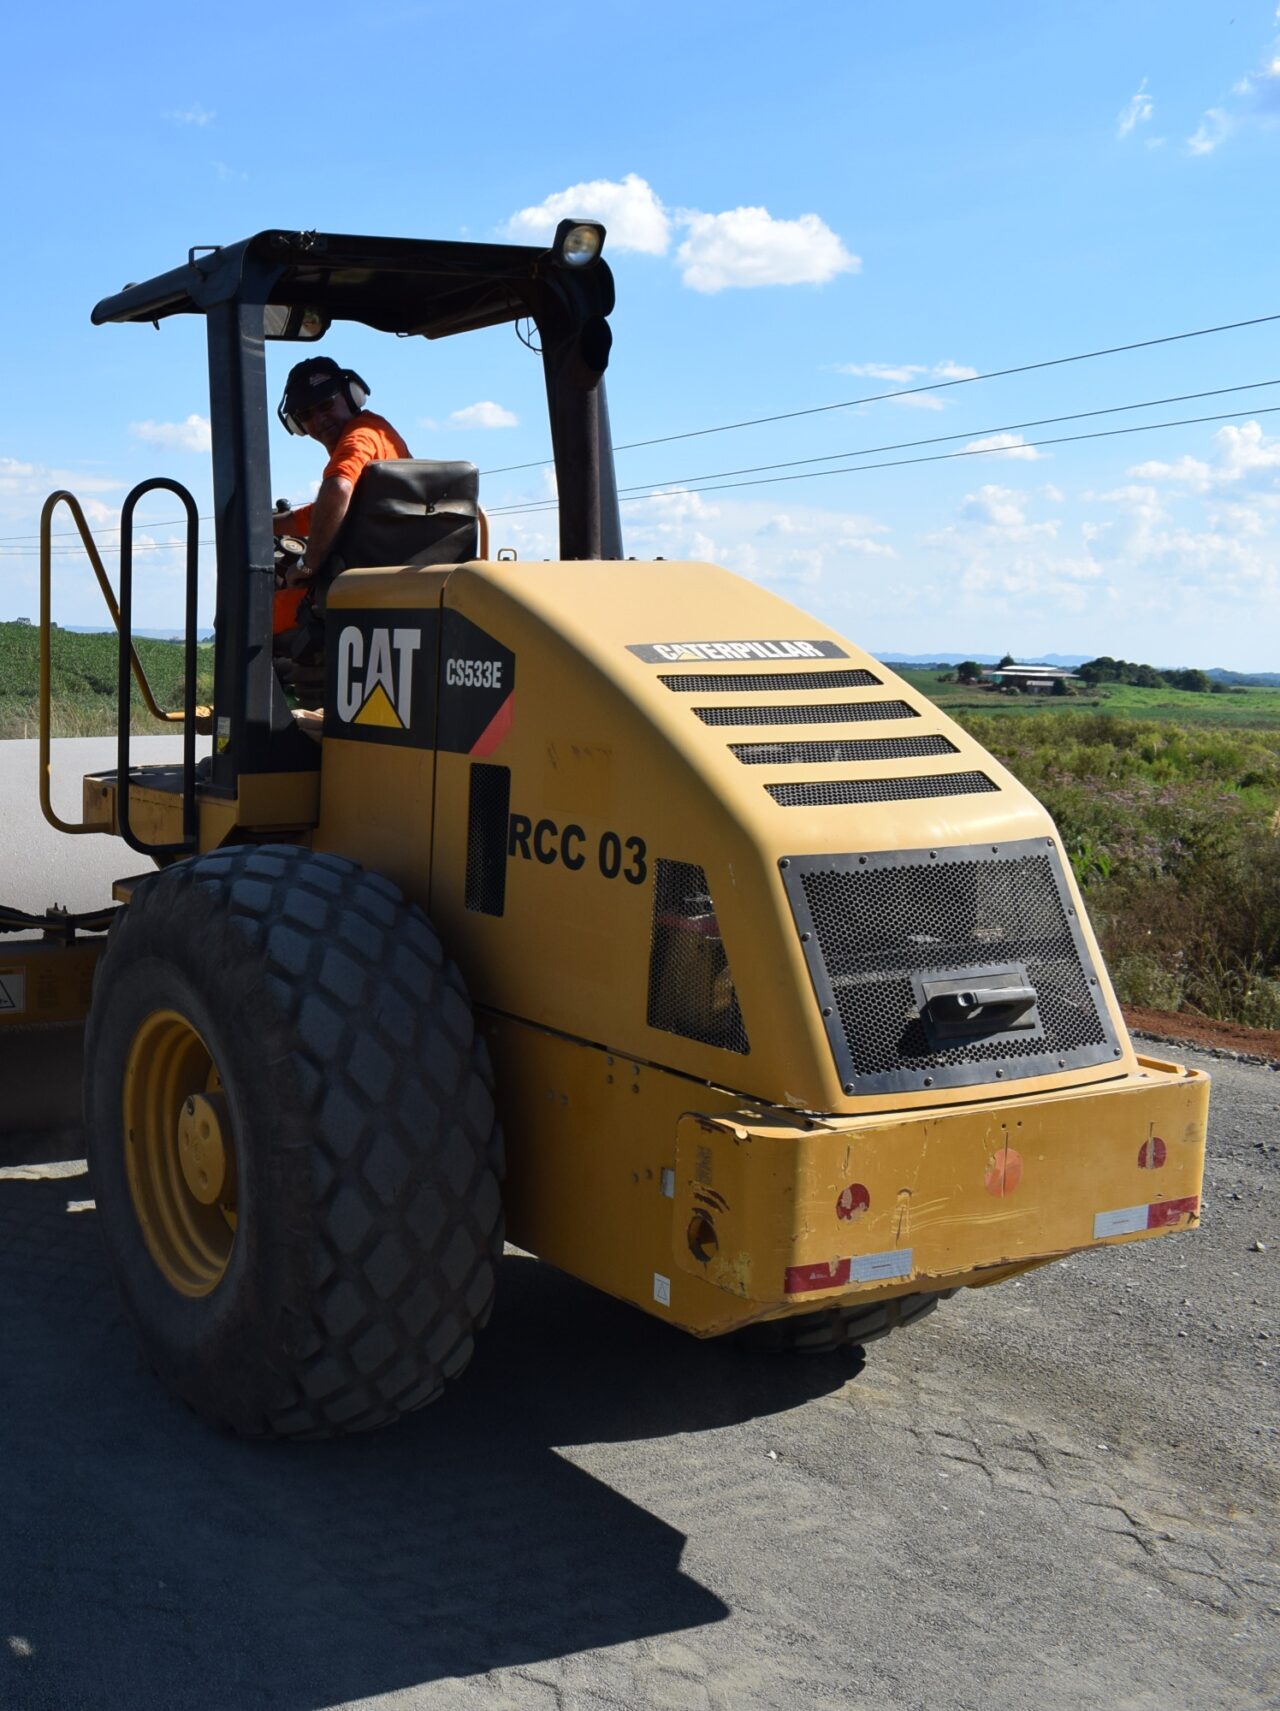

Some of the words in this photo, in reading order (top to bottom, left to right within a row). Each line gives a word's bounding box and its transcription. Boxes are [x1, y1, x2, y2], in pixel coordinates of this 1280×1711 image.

[446, 658, 502, 689] CS533E
[653, 640, 825, 661] CATERPILLAR
[337, 626, 421, 729] CAT
[508, 813, 587, 871] RCC
[598, 831, 648, 886] 03
